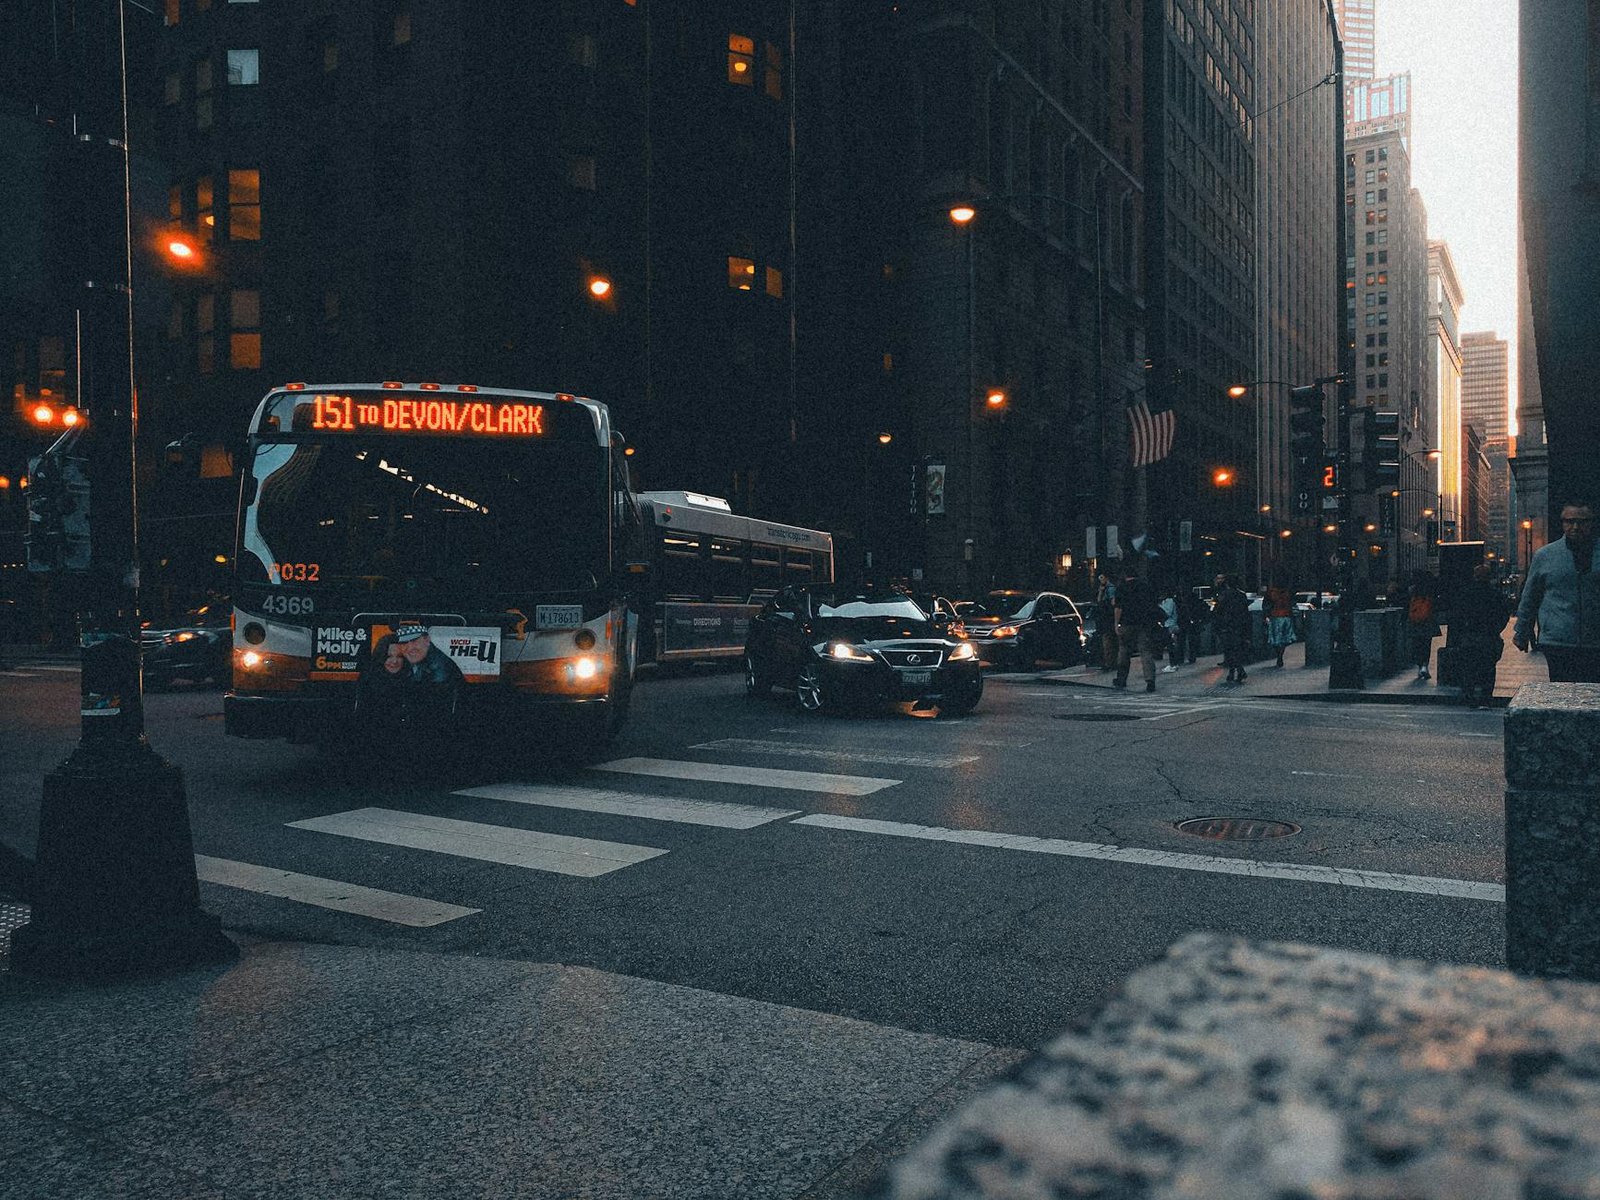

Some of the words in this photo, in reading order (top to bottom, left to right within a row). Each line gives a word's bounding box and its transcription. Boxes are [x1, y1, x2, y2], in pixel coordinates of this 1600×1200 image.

[312, 395, 354, 429] 151
[357, 404, 379, 424] TO
[383, 399, 543, 434] DEVON/CLARK
[1323, 466, 1334, 487] 2
[268, 563, 320, 581] P032
[262, 595, 314, 615] 4369
[317, 627, 354, 641] Mike
[355, 628, 367, 641] &
[317, 640, 361, 656] Molly
[449, 645, 479, 657] THE
[477, 639, 498, 664] U
